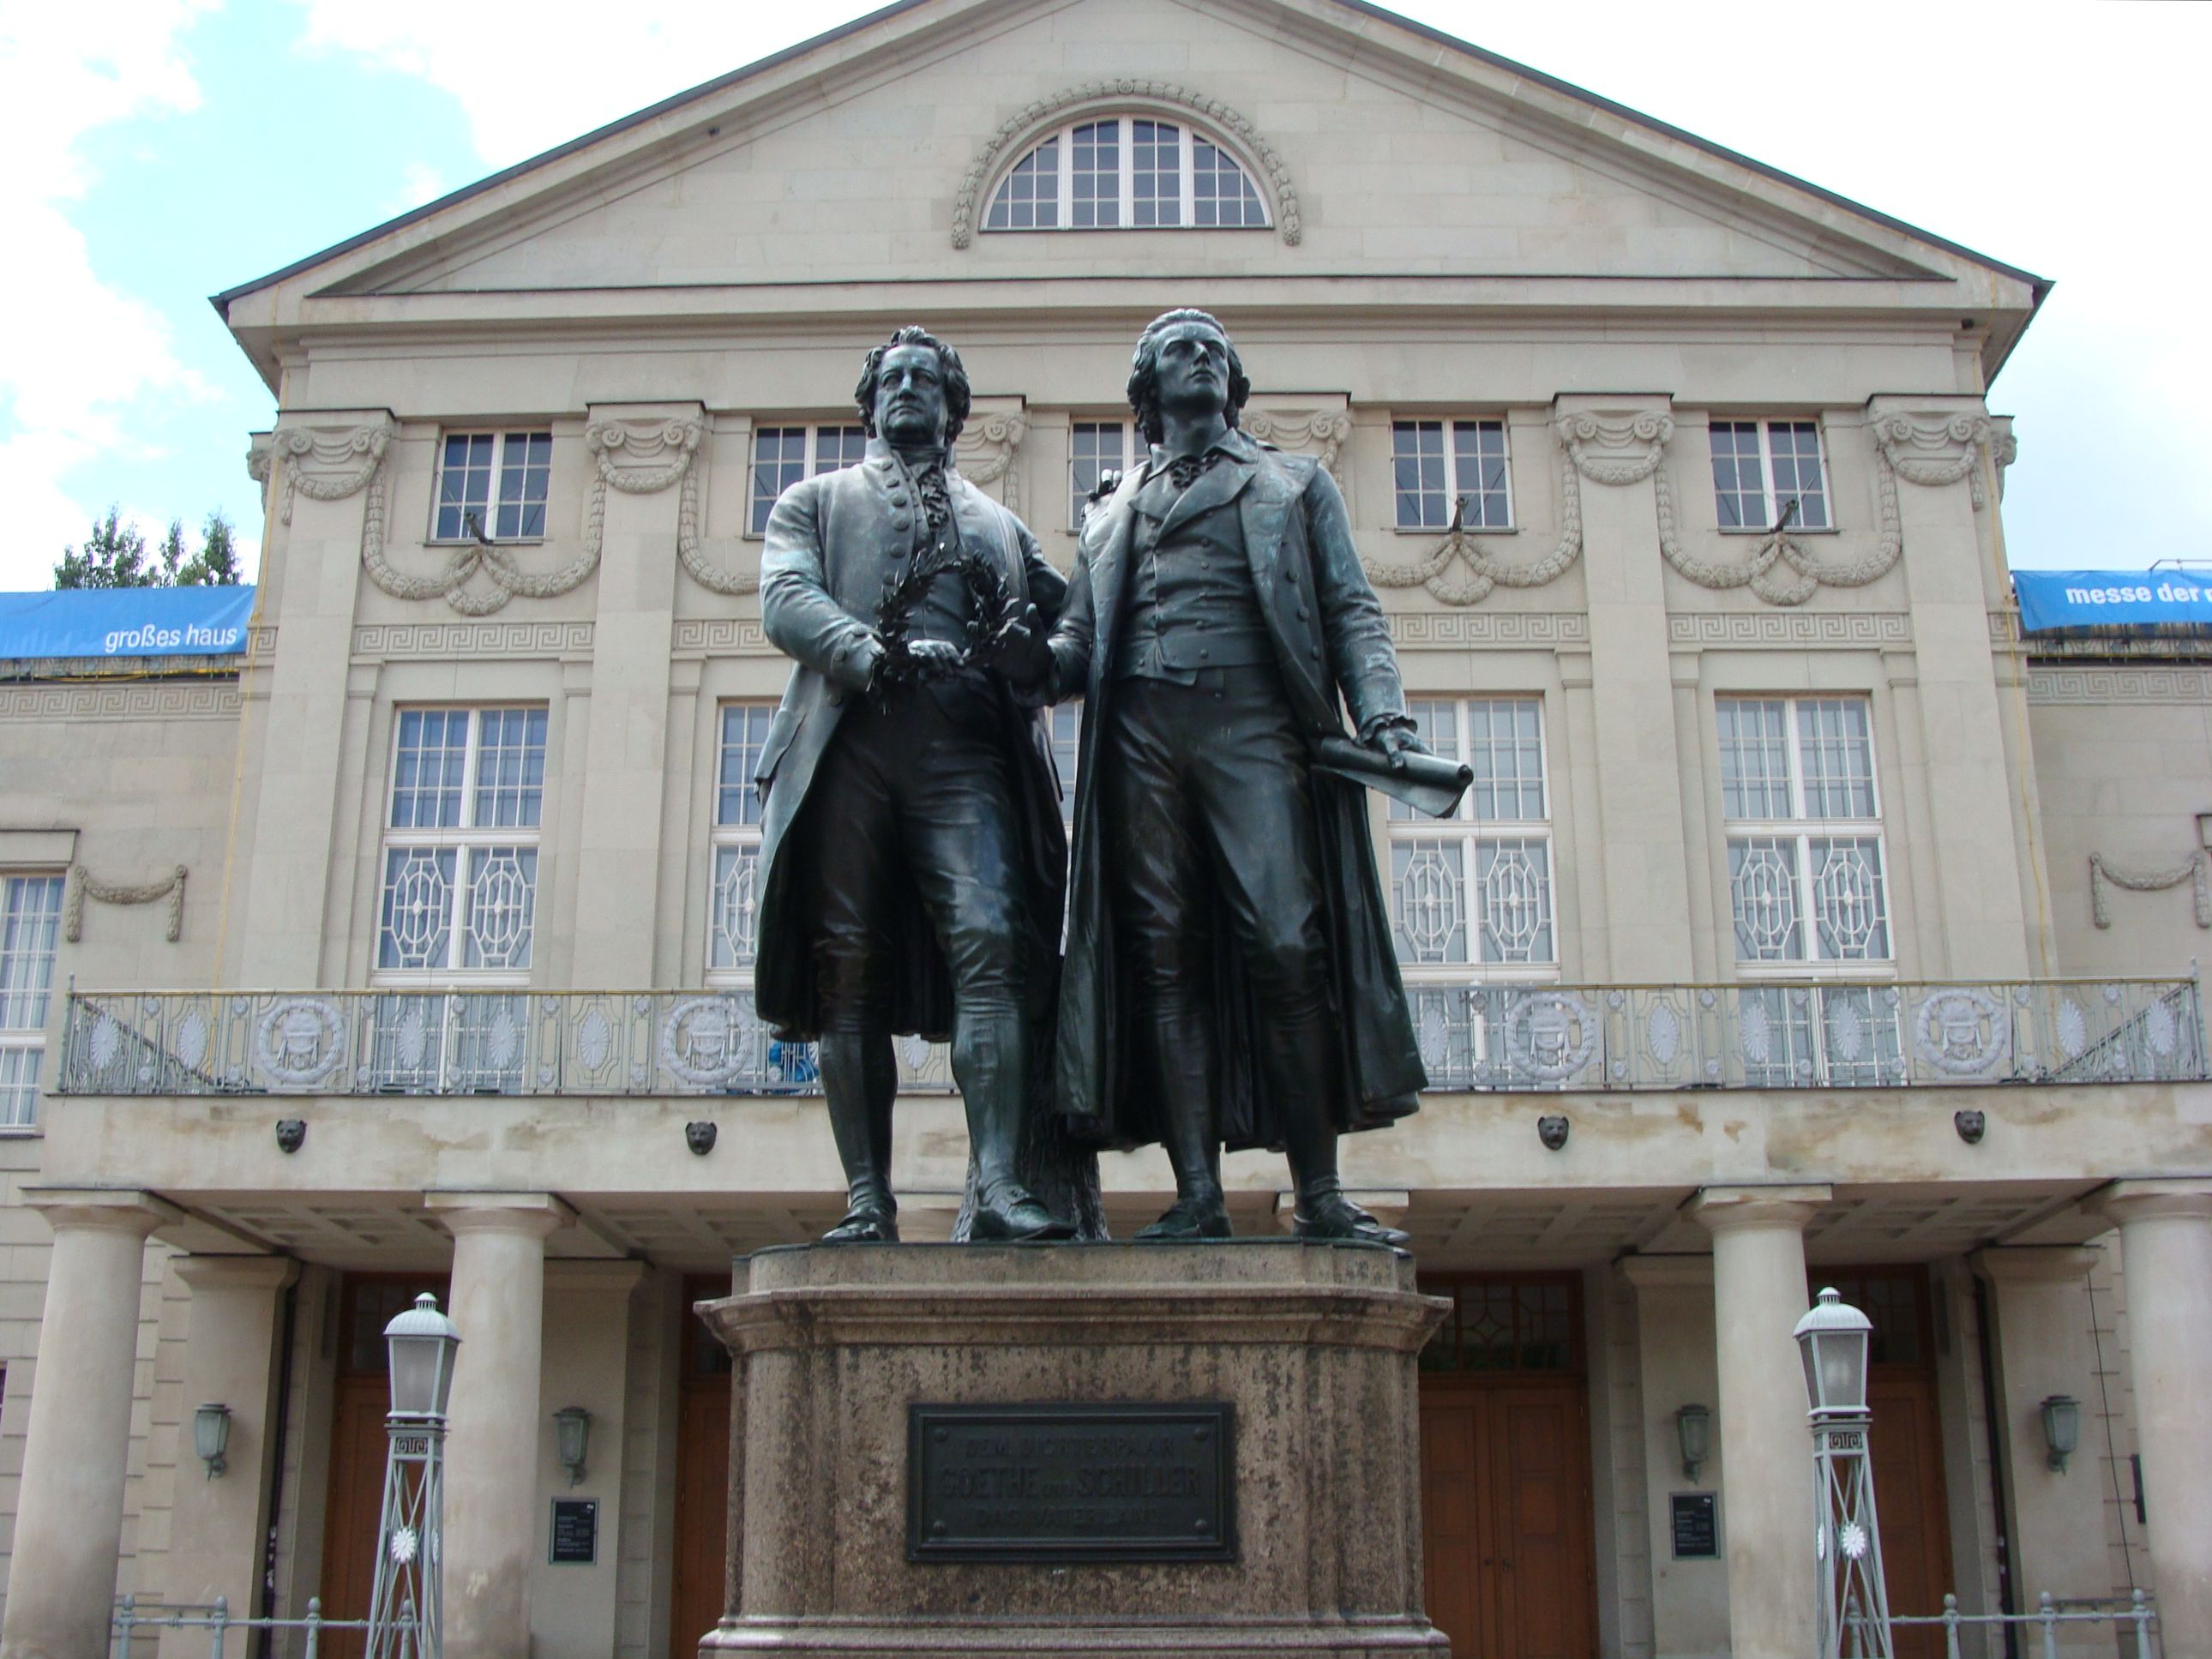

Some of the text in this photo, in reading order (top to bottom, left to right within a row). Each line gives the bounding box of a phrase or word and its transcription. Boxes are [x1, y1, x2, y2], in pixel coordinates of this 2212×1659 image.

[2065, 586, 2152, 604] messe
[2157, 582, 2199, 603] der
[105, 623, 238, 654] großes haus
[966, 1436, 1007, 1458] DEM
[941, 1465, 1039, 1499] GOETHE
[1077, 1464, 1202, 1498] SCHILLER
